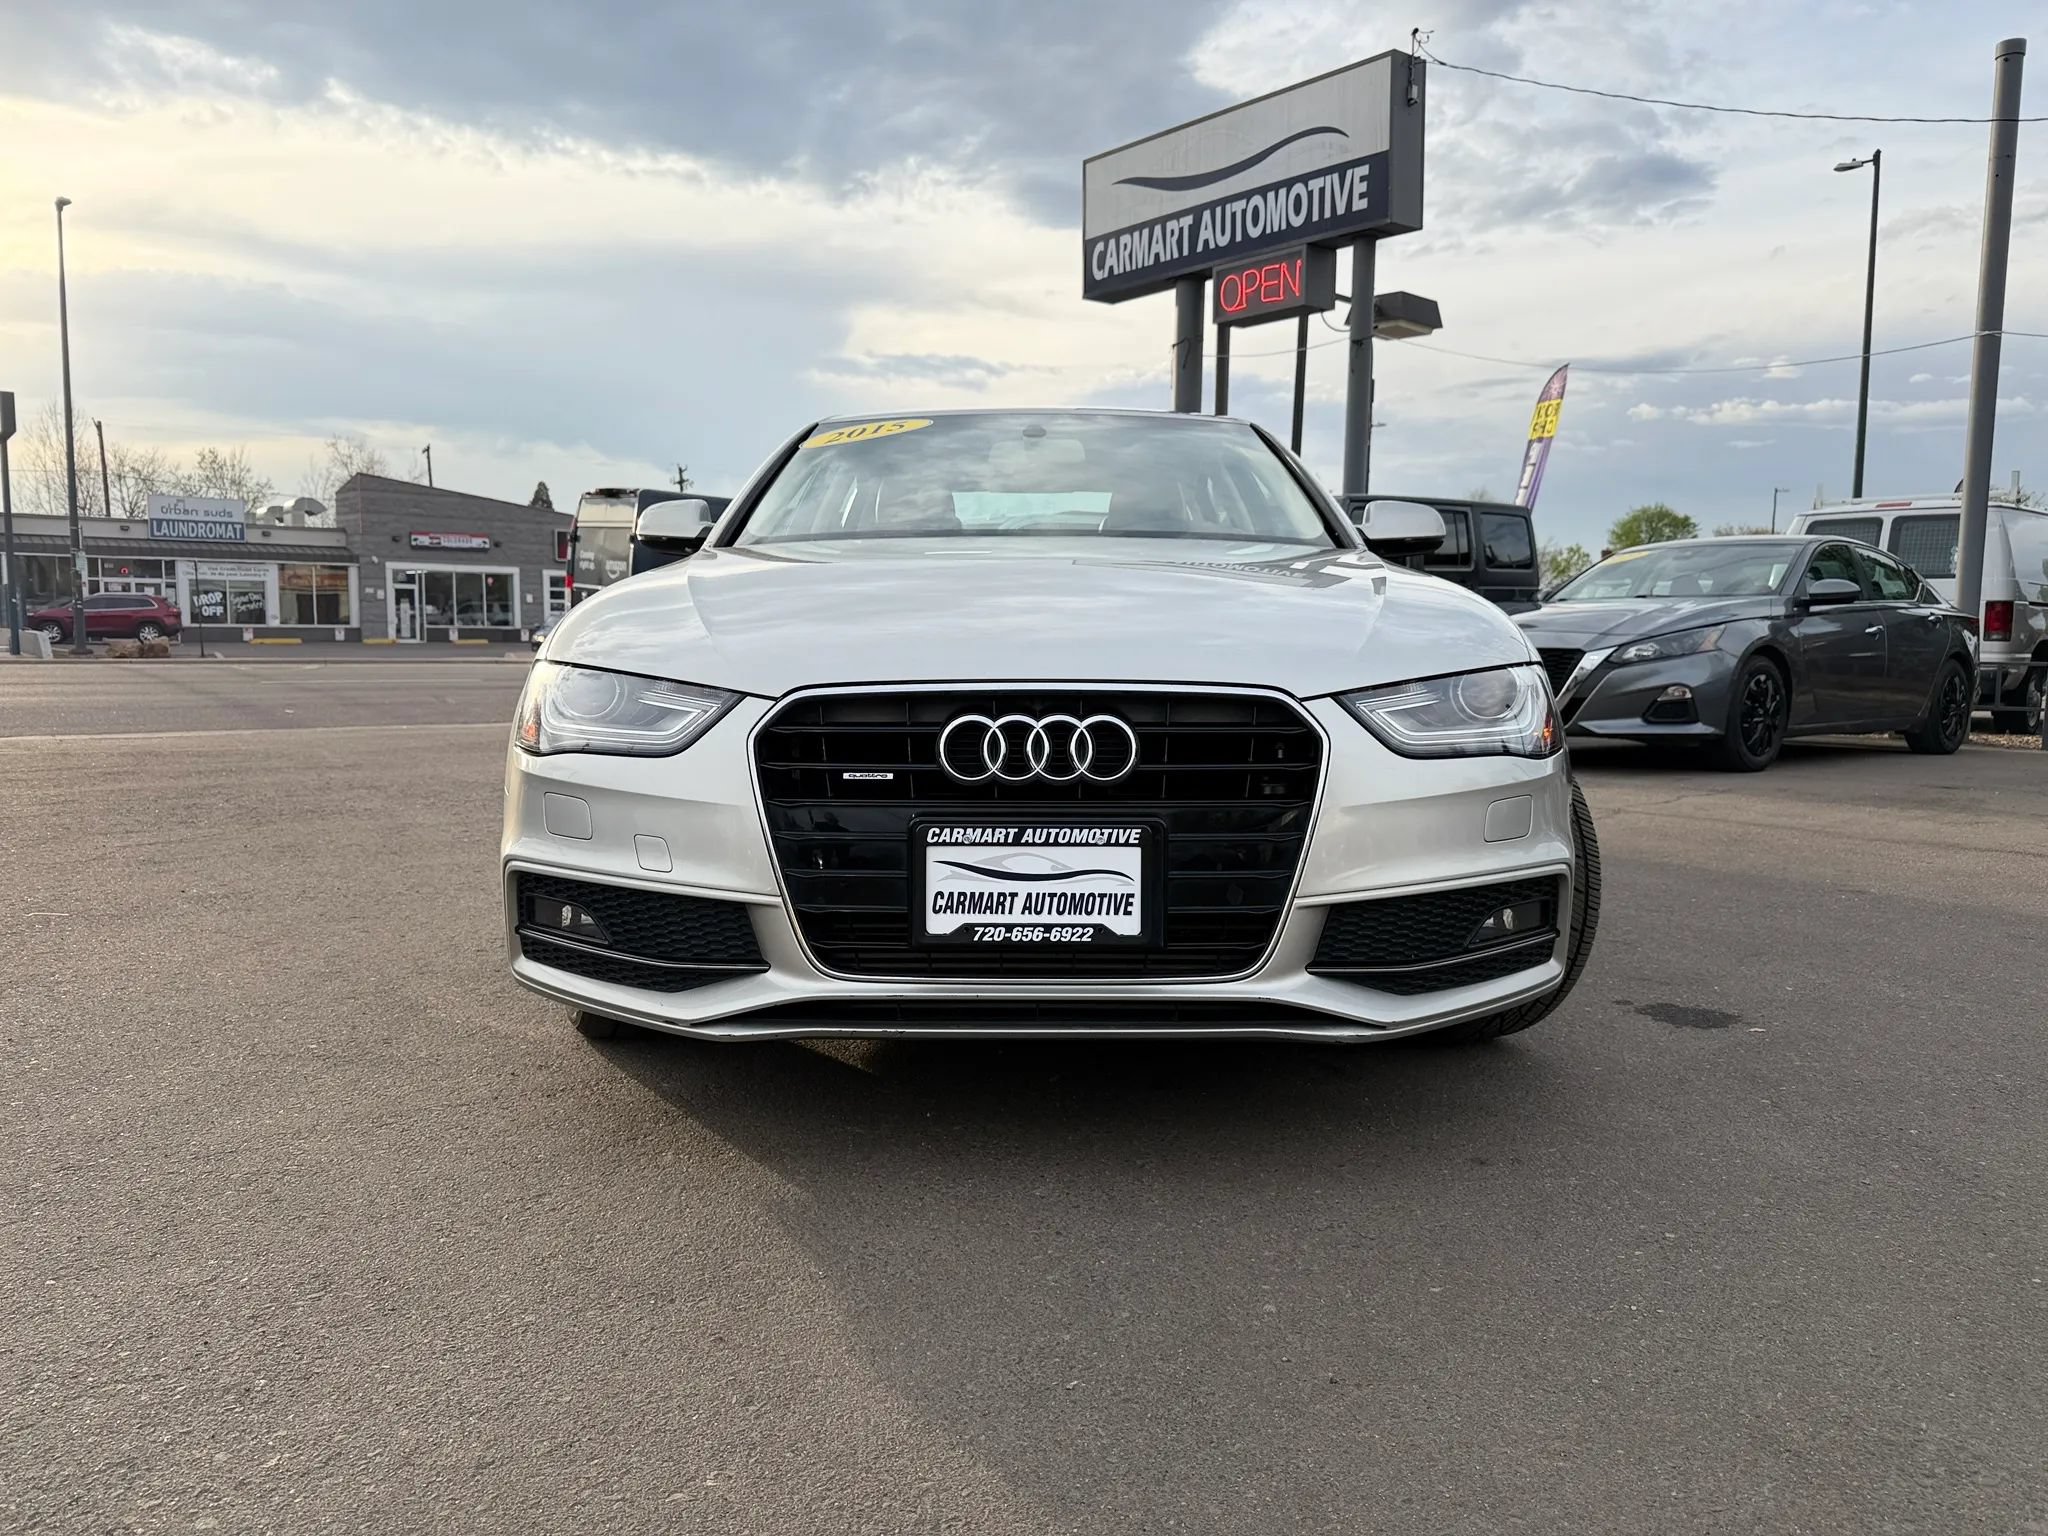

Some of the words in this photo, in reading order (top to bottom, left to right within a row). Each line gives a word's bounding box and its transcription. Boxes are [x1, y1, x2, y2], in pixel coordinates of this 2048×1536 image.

[1092, 214, 1193, 281] CARMART
[1197, 164, 1370, 253] AUTOMOTIVE
[1219, 260, 1302, 312] OPEN
[823, 421, 908, 445] 2015
[203, 508, 234, 519] suds
[152, 519, 242, 539] LAUNDROMAT
[201, 605, 225, 617] OFF
[926, 827, 1018, 844] CARMART
[1021, 828, 1141, 844] AUTOMOTIVE
[931, 890, 1019, 915] CARMART
[1021, 892, 1135, 916] AUTOMOTIVE
[973, 926, 1094, 942] 720-656-6922
